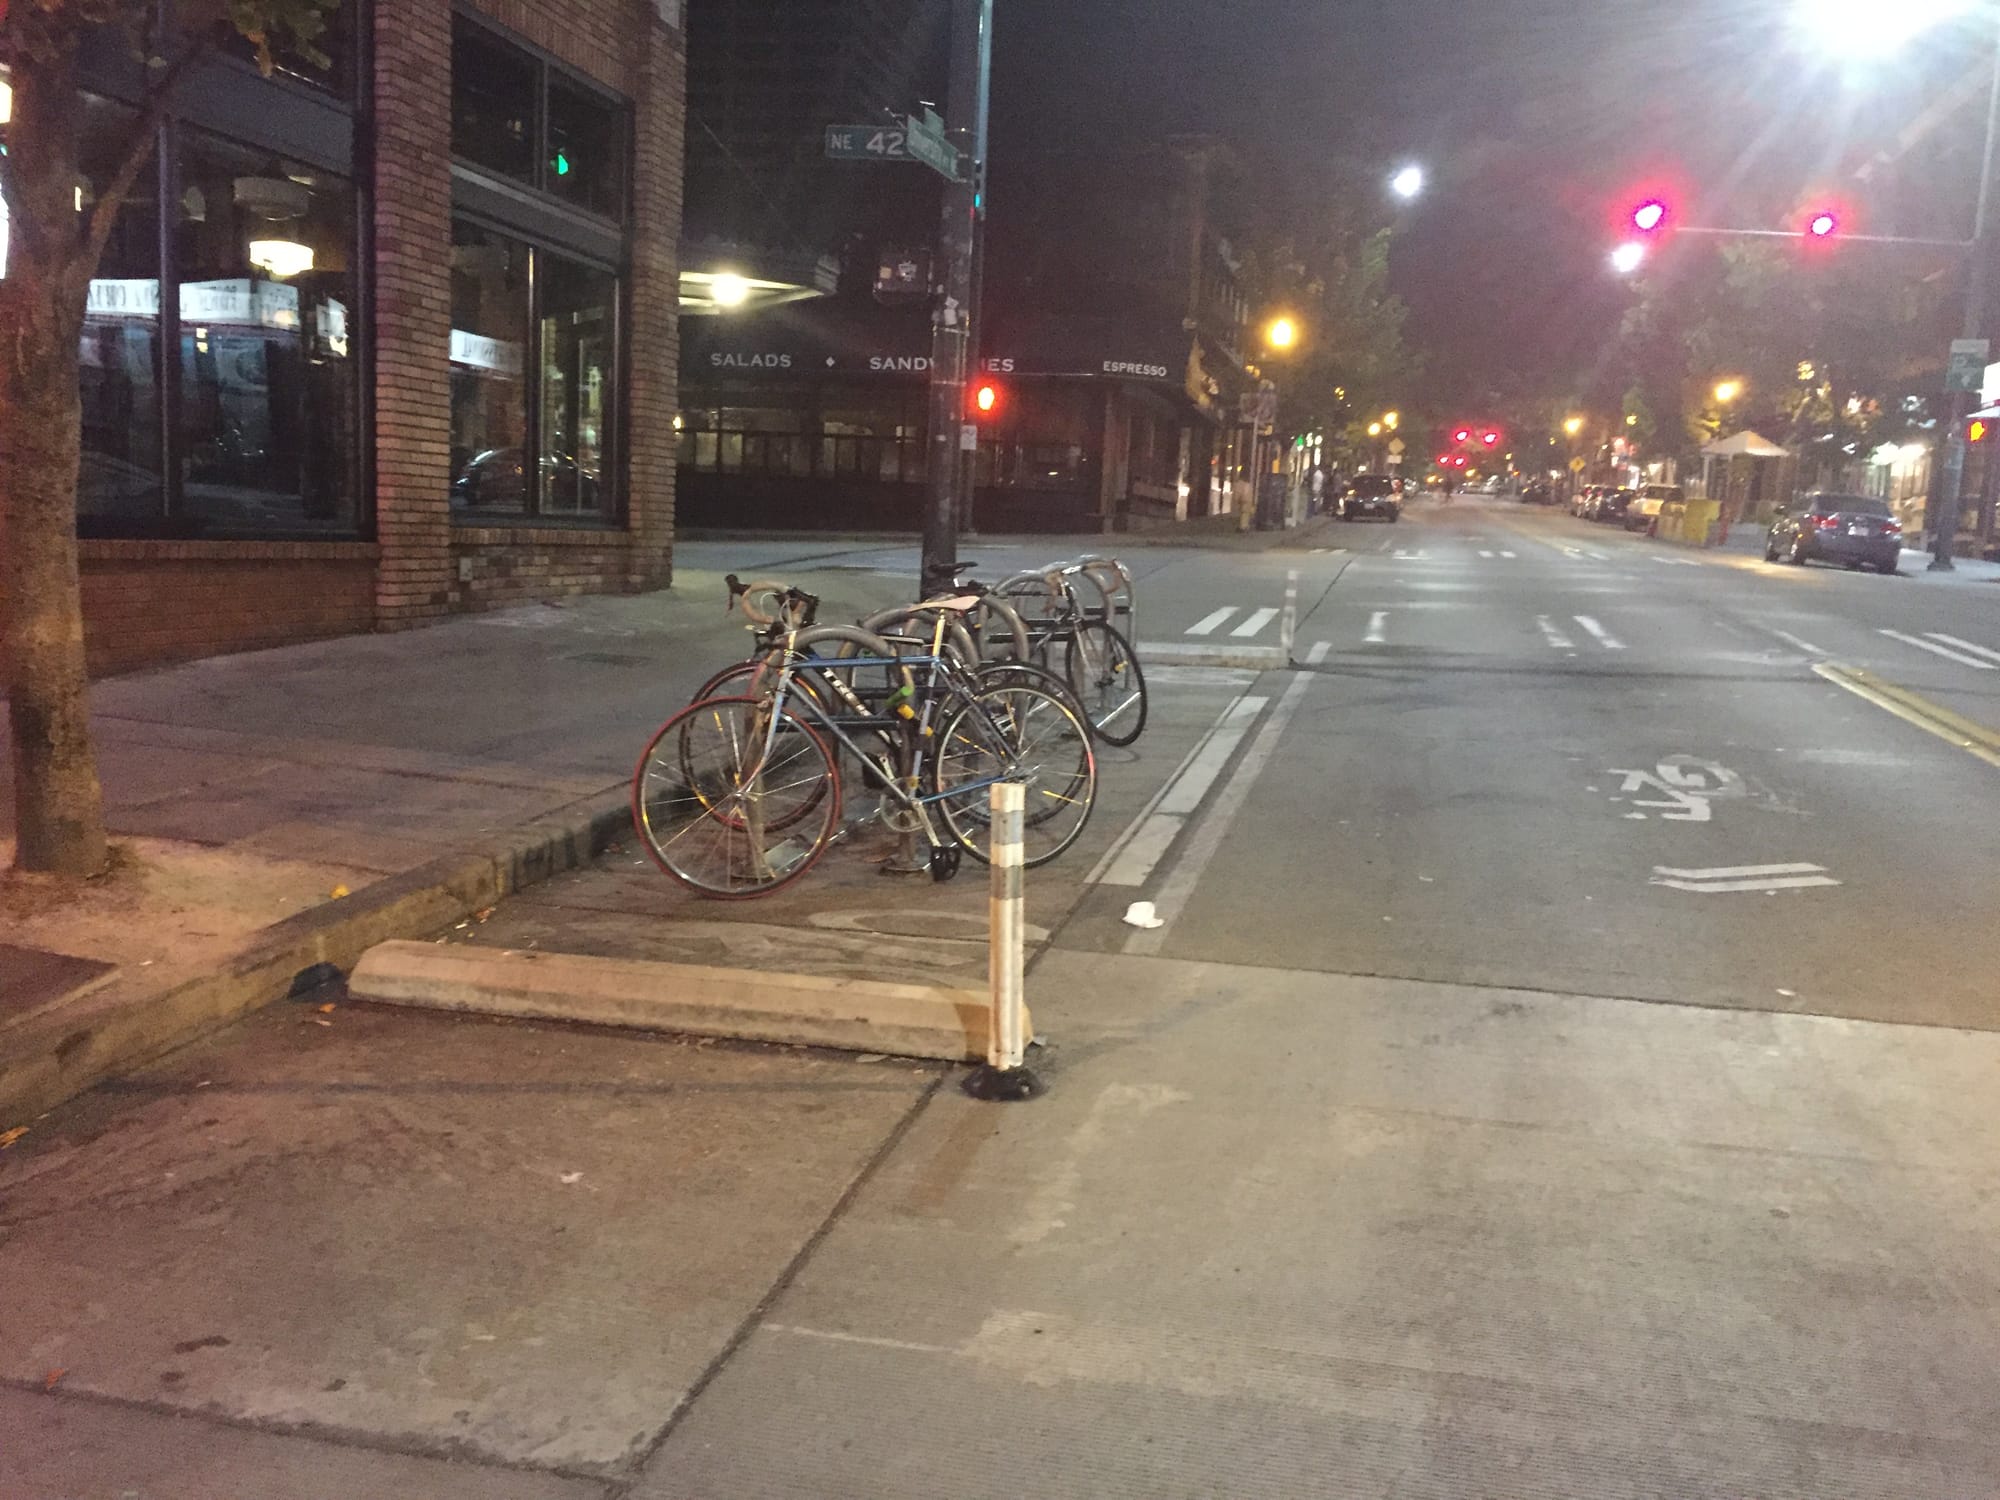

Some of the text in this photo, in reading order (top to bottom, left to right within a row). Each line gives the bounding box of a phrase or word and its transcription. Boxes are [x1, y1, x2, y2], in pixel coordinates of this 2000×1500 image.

[831, 131, 905, 155] NE 42
[709, 352, 1014, 372] SALADS SANDES
[1102, 360, 1167, 376] ESPRESSO
